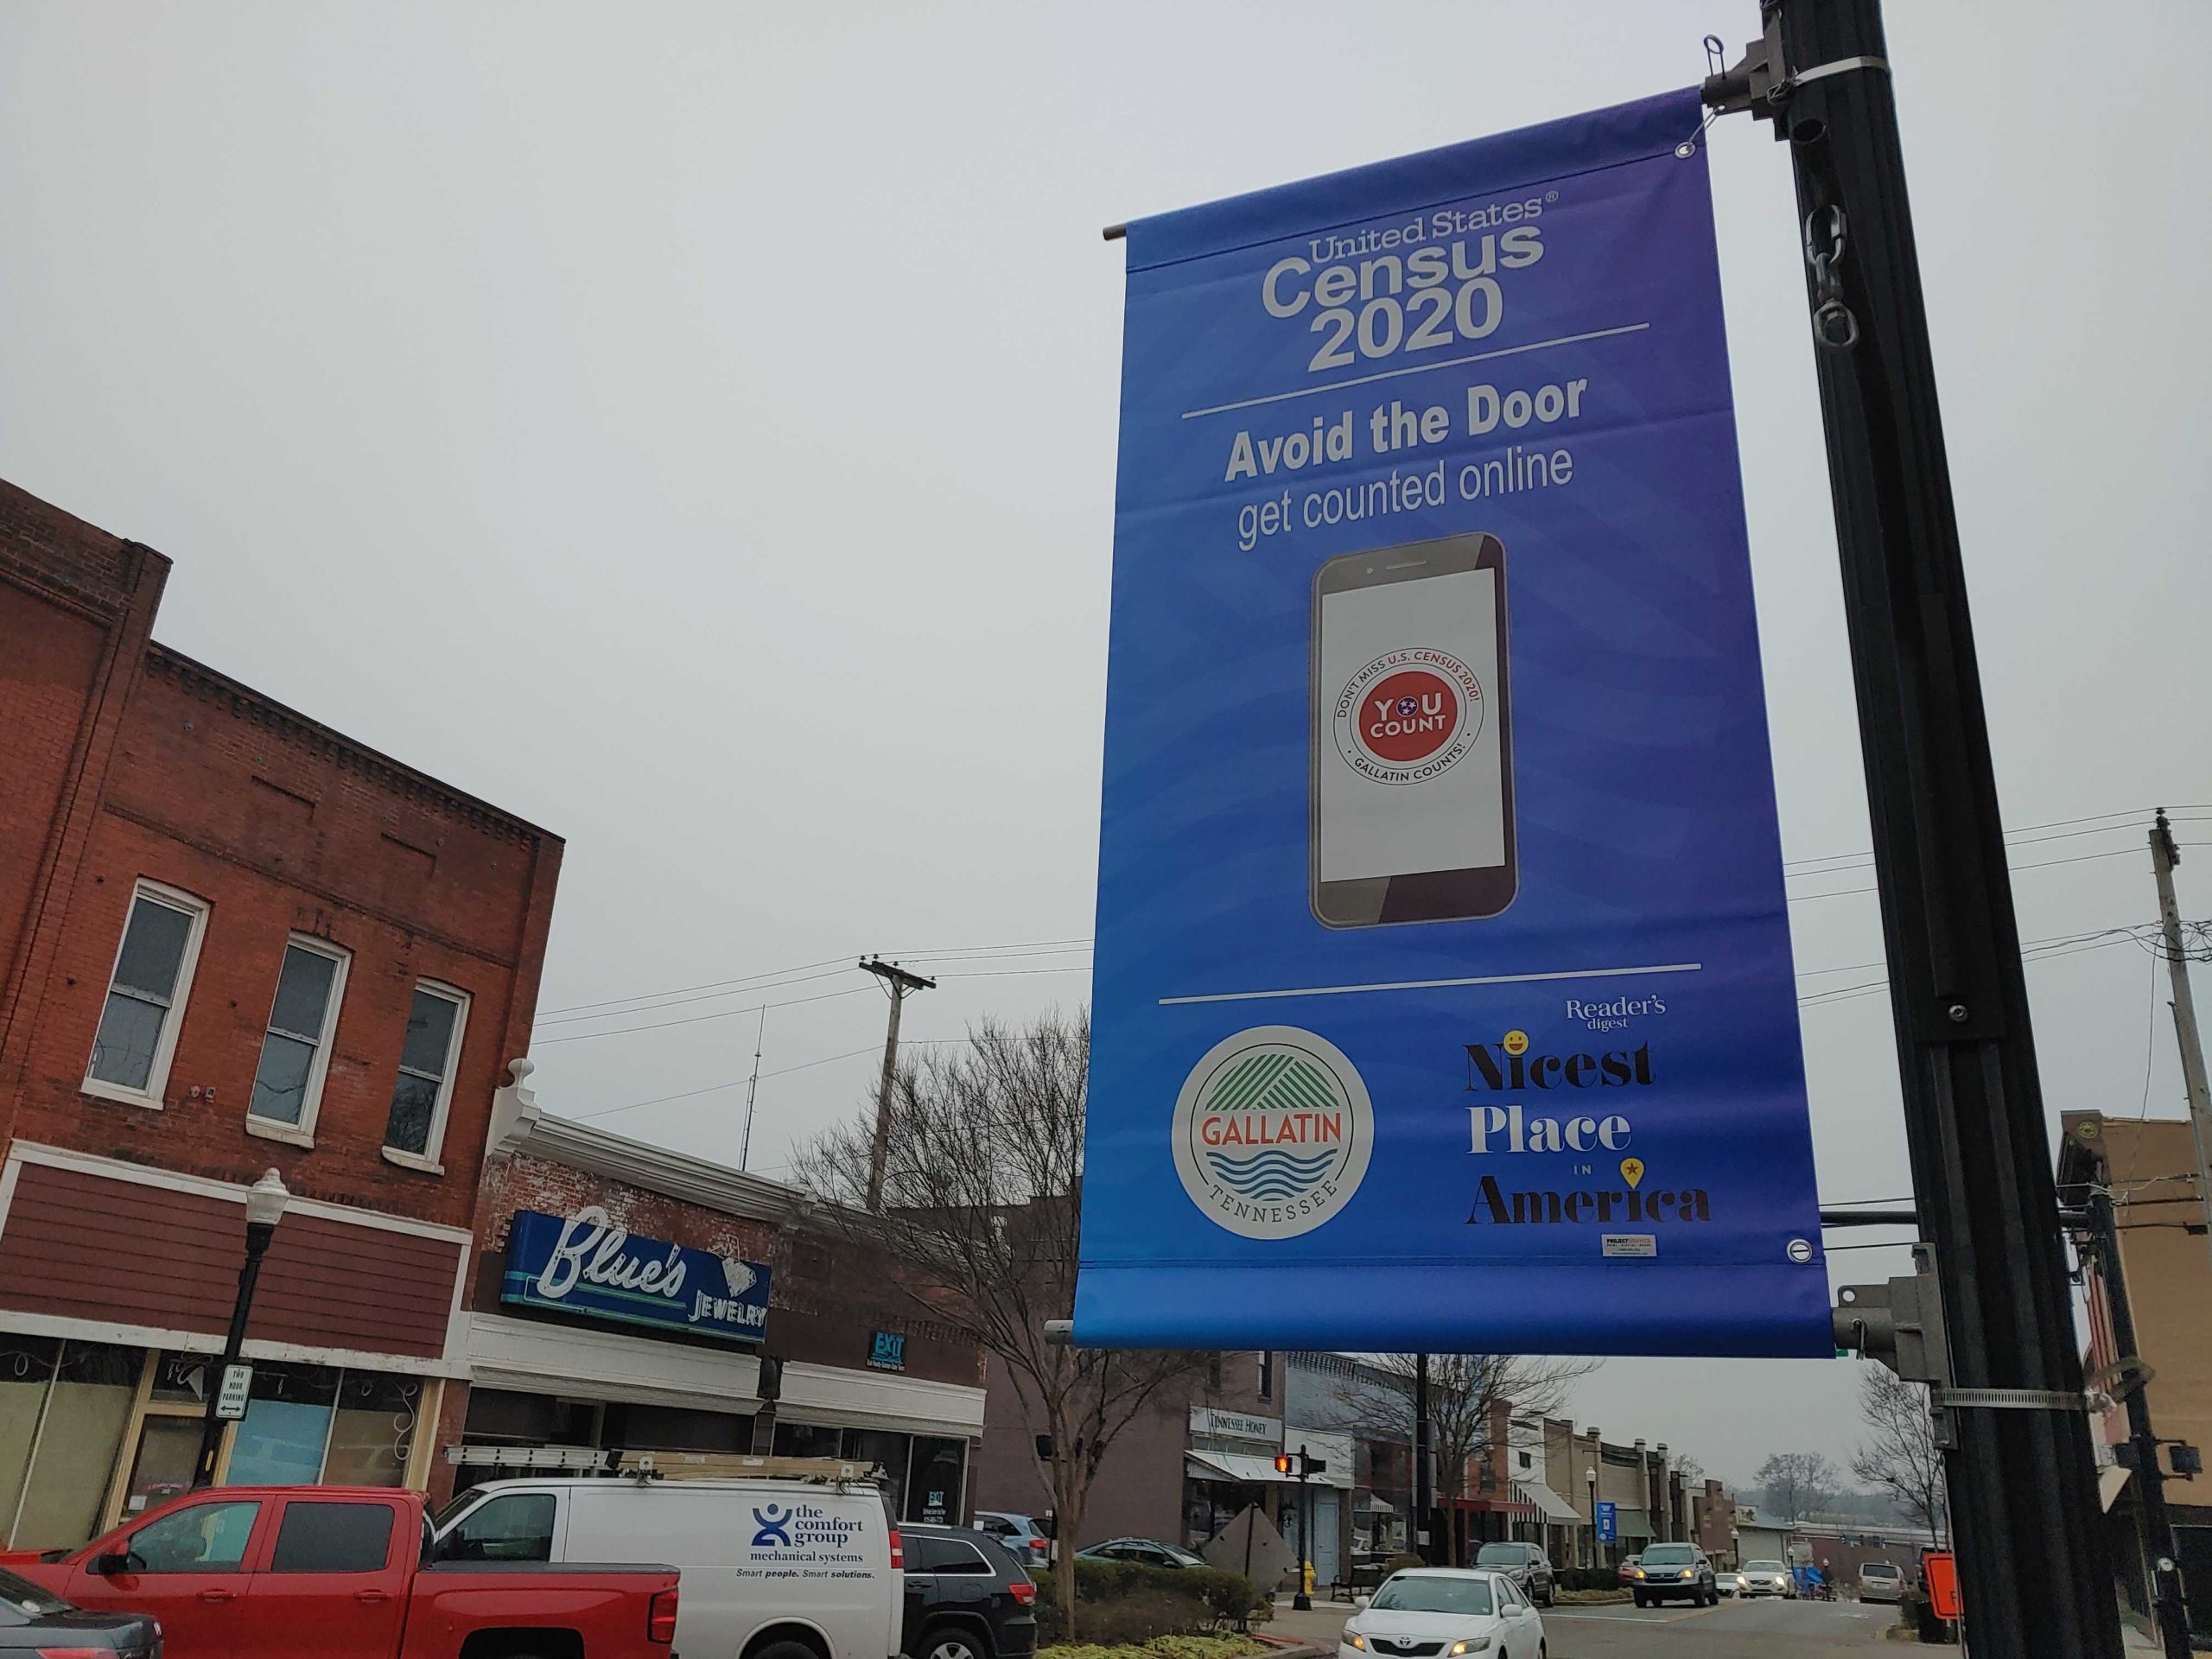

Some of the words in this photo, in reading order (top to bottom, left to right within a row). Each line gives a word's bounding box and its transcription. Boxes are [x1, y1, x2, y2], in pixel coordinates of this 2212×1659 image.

[1309, 217, 1427, 264] United
[1262, 226, 1544, 318] Census
[1308, 276, 1503, 372] 2020
[1224, 410, 1353, 482] Avoid
[1370, 400, 1450, 454] the
[1468, 378, 1587, 436] Door
[1238, 489, 1292, 551] get
[1303, 459, 1446, 528] counted
[1459, 447, 1573, 502] online
[1337, 682, 1360, 718] DON'T
[1358, 661, 1385, 683] MISS
[1388, 653, 1410, 664] U.S.
[1414, 652, 1462, 674] CENSUS
[1458, 671, 1480, 702] 2020!
[1370, 715, 1446, 739] COUNT
[1354, 757, 1409, 782] GALLATIN
[1413, 742, 1466, 779] COUNTS!
[1565, 994, 1667, 1020] Reader's
[1586, 1017, 1628, 1033] digest
[1462, 1038, 1656, 1092] Nicest
[1202, 1112, 1341, 1147] GALLATIN
[1465, 1104, 1631, 1154] Place
[1573, 1165, 1592, 1175] IN
[1209, 1179, 1338, 1223] TENNESSEE
[1462, 1173, 1712, 1225] America
[536, 1205, 687, 1298] Blue's
[688, 1289, 767, 1328] JEWELRY
[222, 1393, 245, 1402] PARKING
[1210, 1413, 1243, 1432] TENNESSEE
[1245, 1418, 1268, 1435] HONEY
[795, 1504, 823, 1518] the
[795, 1516, 863, 1532] comfort
[750, 1550, 816, 1562] mechanical
[818, 1554, 863, 1565] systems
[794, 1532, 849, 1548] group
[735, 1568, 763, 1578] Smart
[765, 1569, 799, 1580] people.
[802, 1569, 828, 1578] Smart
[831, 1570, 875, 1580] solutions.
